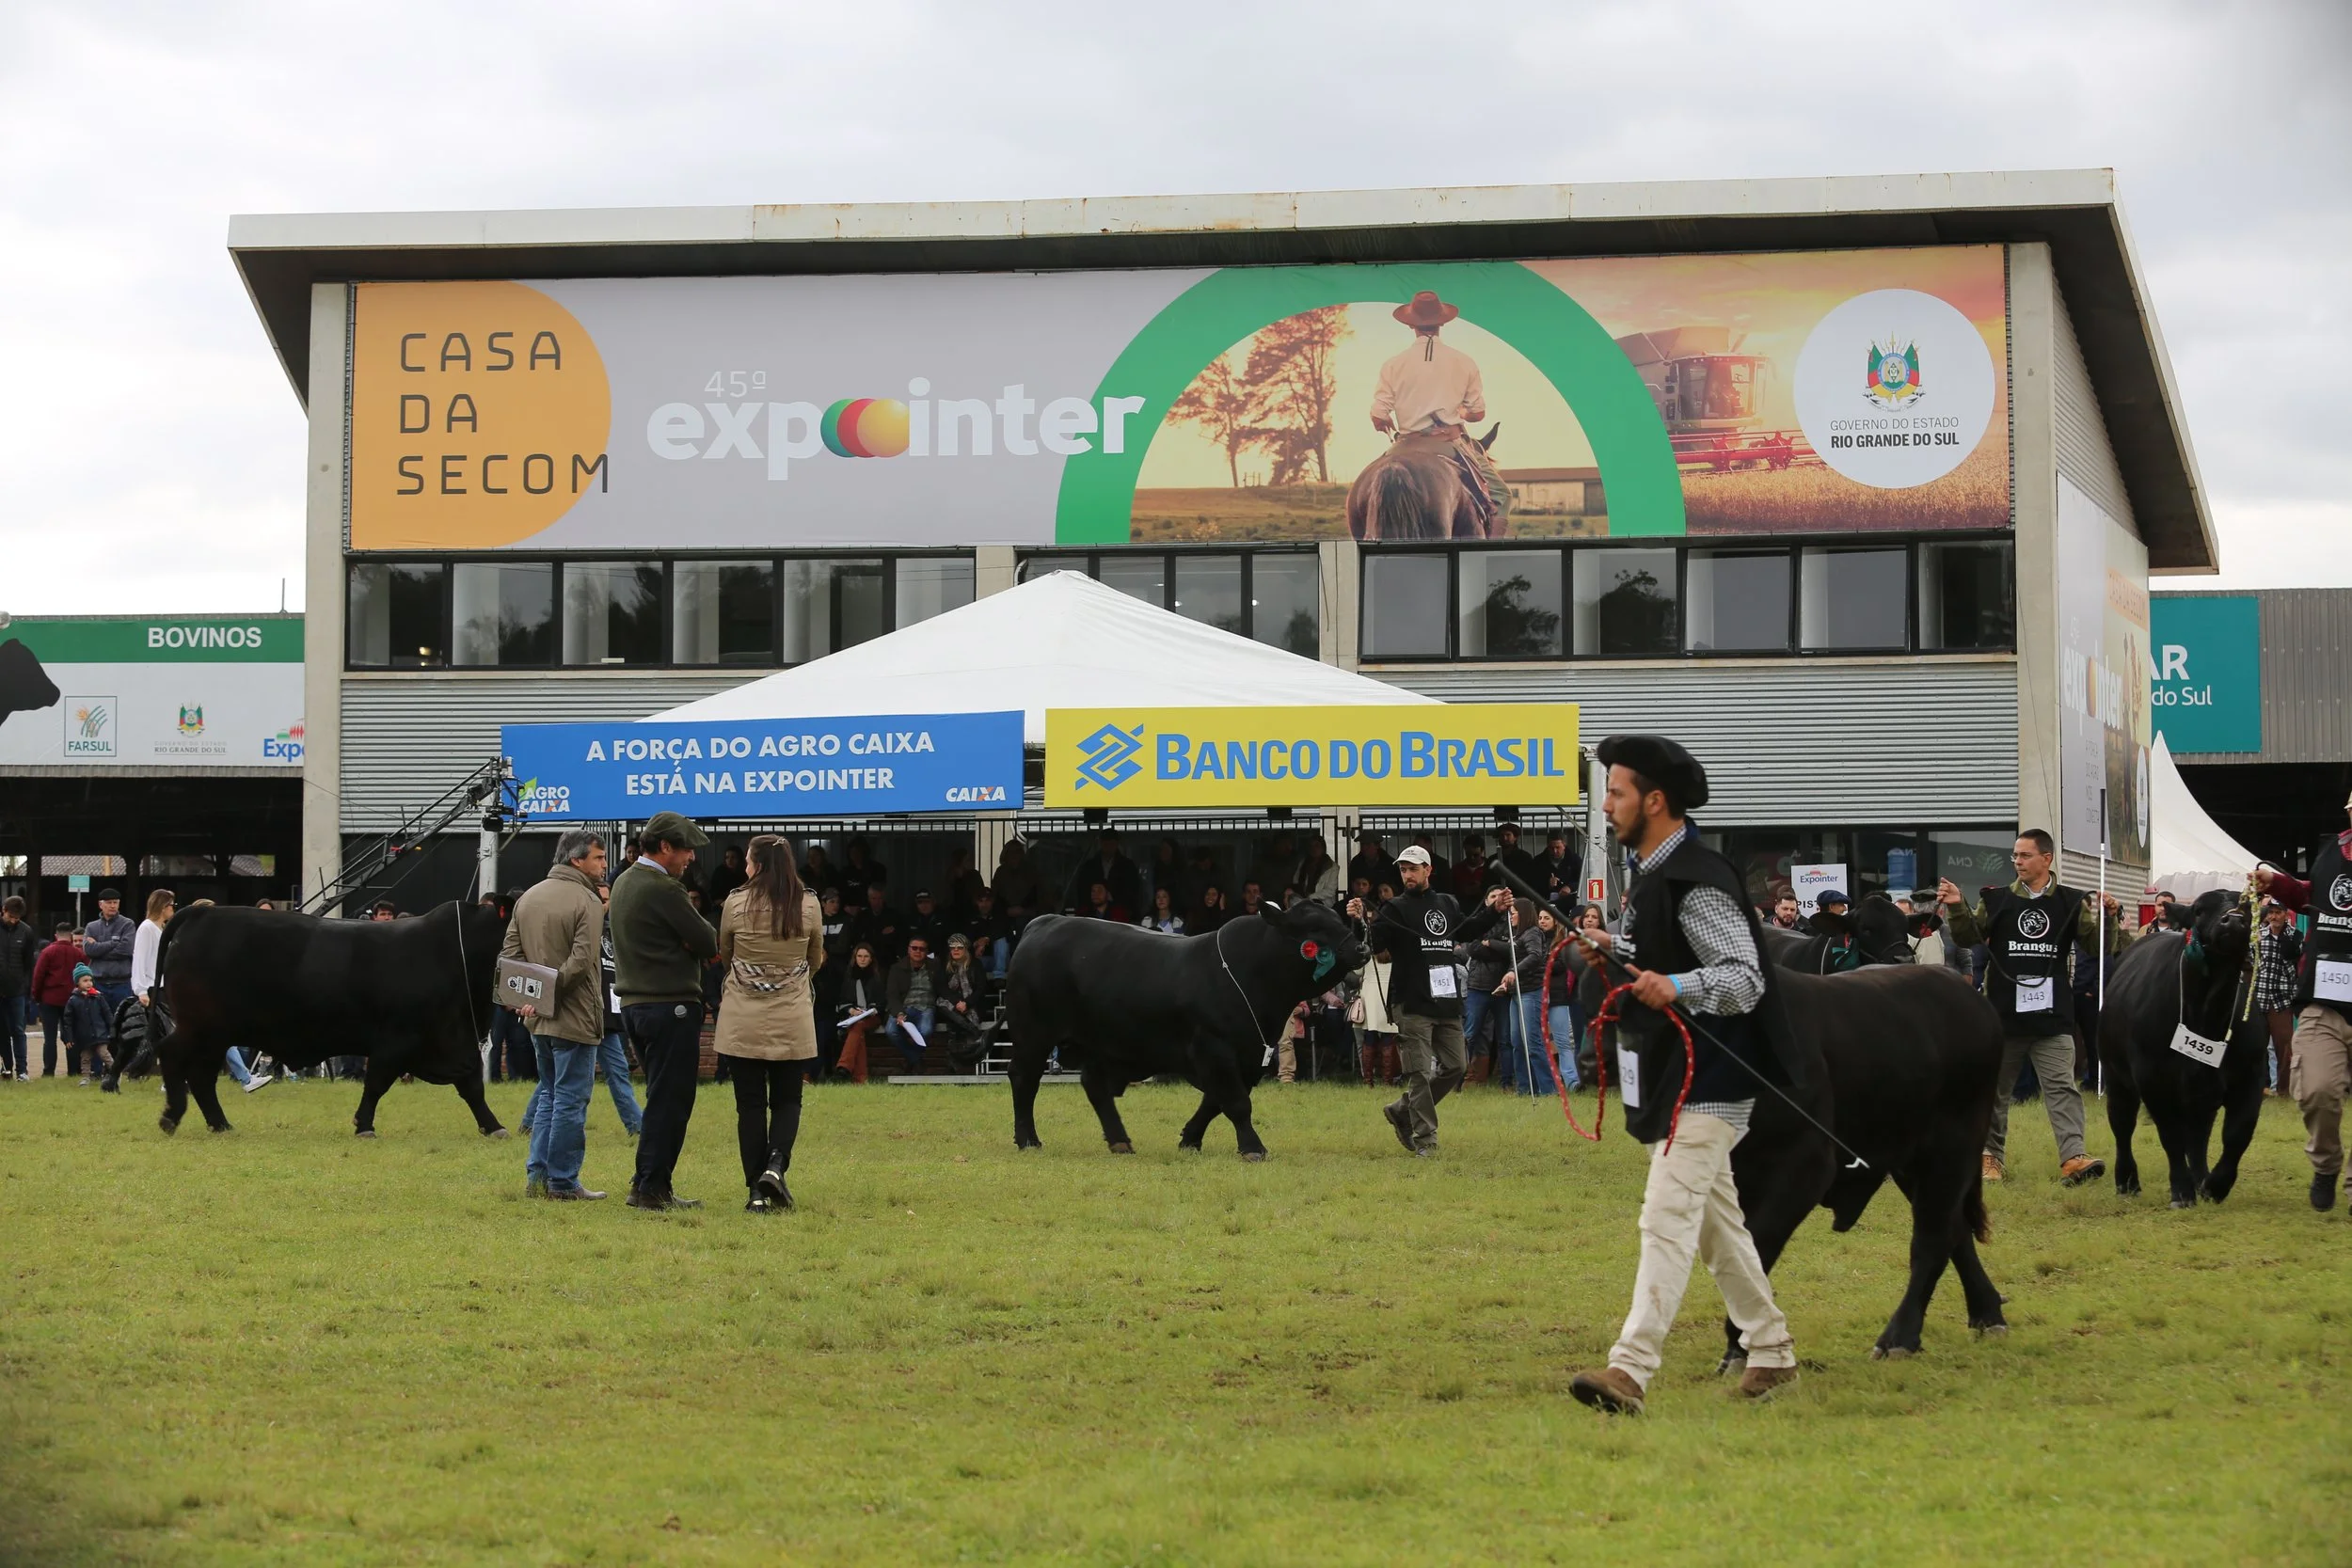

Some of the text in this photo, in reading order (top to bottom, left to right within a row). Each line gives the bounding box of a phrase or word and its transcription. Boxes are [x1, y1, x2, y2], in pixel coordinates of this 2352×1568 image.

[400, 331, 563, 372] CASA
[400, 393, 479, 435] DA
[646, 377, 1147, 481] expointer
[1830, 417, 1959, 432] GOVERNO DO ESTADO
[1831, 432, 1960, 449] RIO GRANDE DO SUL
[397, 453, 609, 496] SECOM
[148, 626, 262, 648] BOVINOS
[2152, 685, 2213, 705] do Sul
[69, 741, 112, 752] FARSUL
[585, 731, 935, 767] A FORÇA DO AGRO CAIXA
[1156, 731, 1565, 780] BANCO DO BRASIL
[626, 767, 895, 796] ESTÁ NA EXPOINTER
[524, 786, 570, 800] AGRO
[945, 786, 1007, 803] CAIXA
[519, 800, 570, 813] CAIXA
[1800, 875, 1838, 885] Expointer
[1797, 900, 1817, 909] PIS
[2321, 972, 2350, 985] 1450
[2022, 991, 2045, 1004] 1443
[2184, 1035, 2214, 1055] 1439
